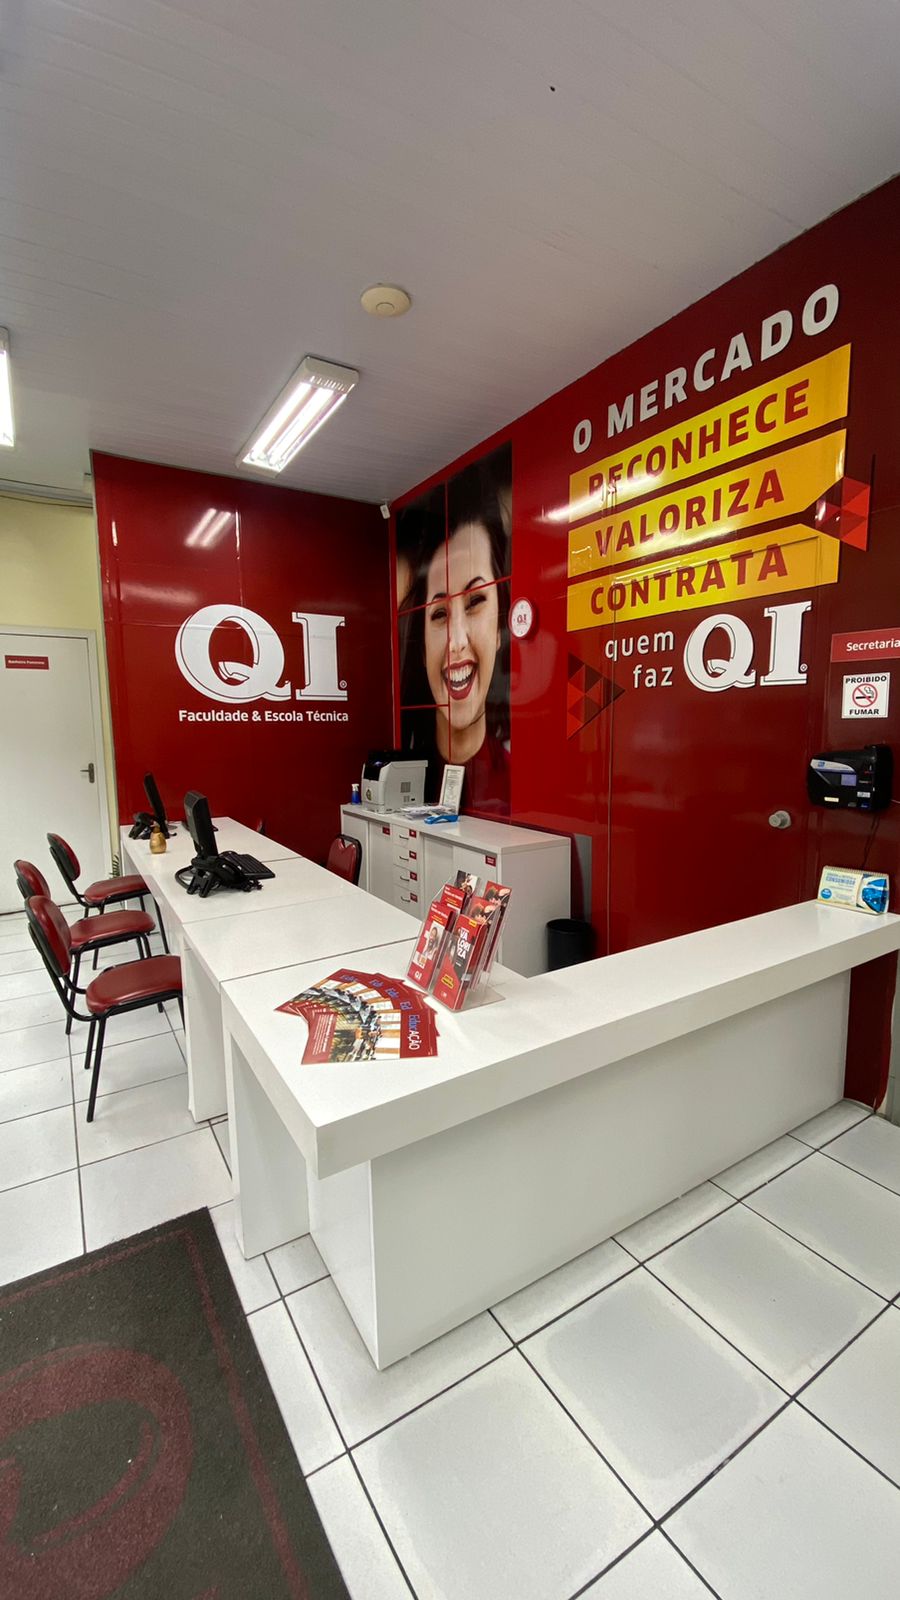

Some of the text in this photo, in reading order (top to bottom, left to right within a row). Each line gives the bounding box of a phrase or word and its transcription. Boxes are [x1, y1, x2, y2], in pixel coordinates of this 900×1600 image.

[573, 283, 839, 453] O MERCADO
[588, 378, 810, 499] RECONHECE
[595, 468, 785, 557] VALORIZA
[590, 543, 788, 615] CONTRATA
[175, 604, 348, 704] QI
[604, 630, 674, 662] quem
[683, 601, 812, 693] QI
[846, 638, 900, 652] Secretaria
[633, 664, 673, 688] faz
[845, 675, 887, 684] PROIBIDO
[178, 710, 349, 722] Faculdade & Escola Técnica
[849, 708, 880, 716] FUMAR
